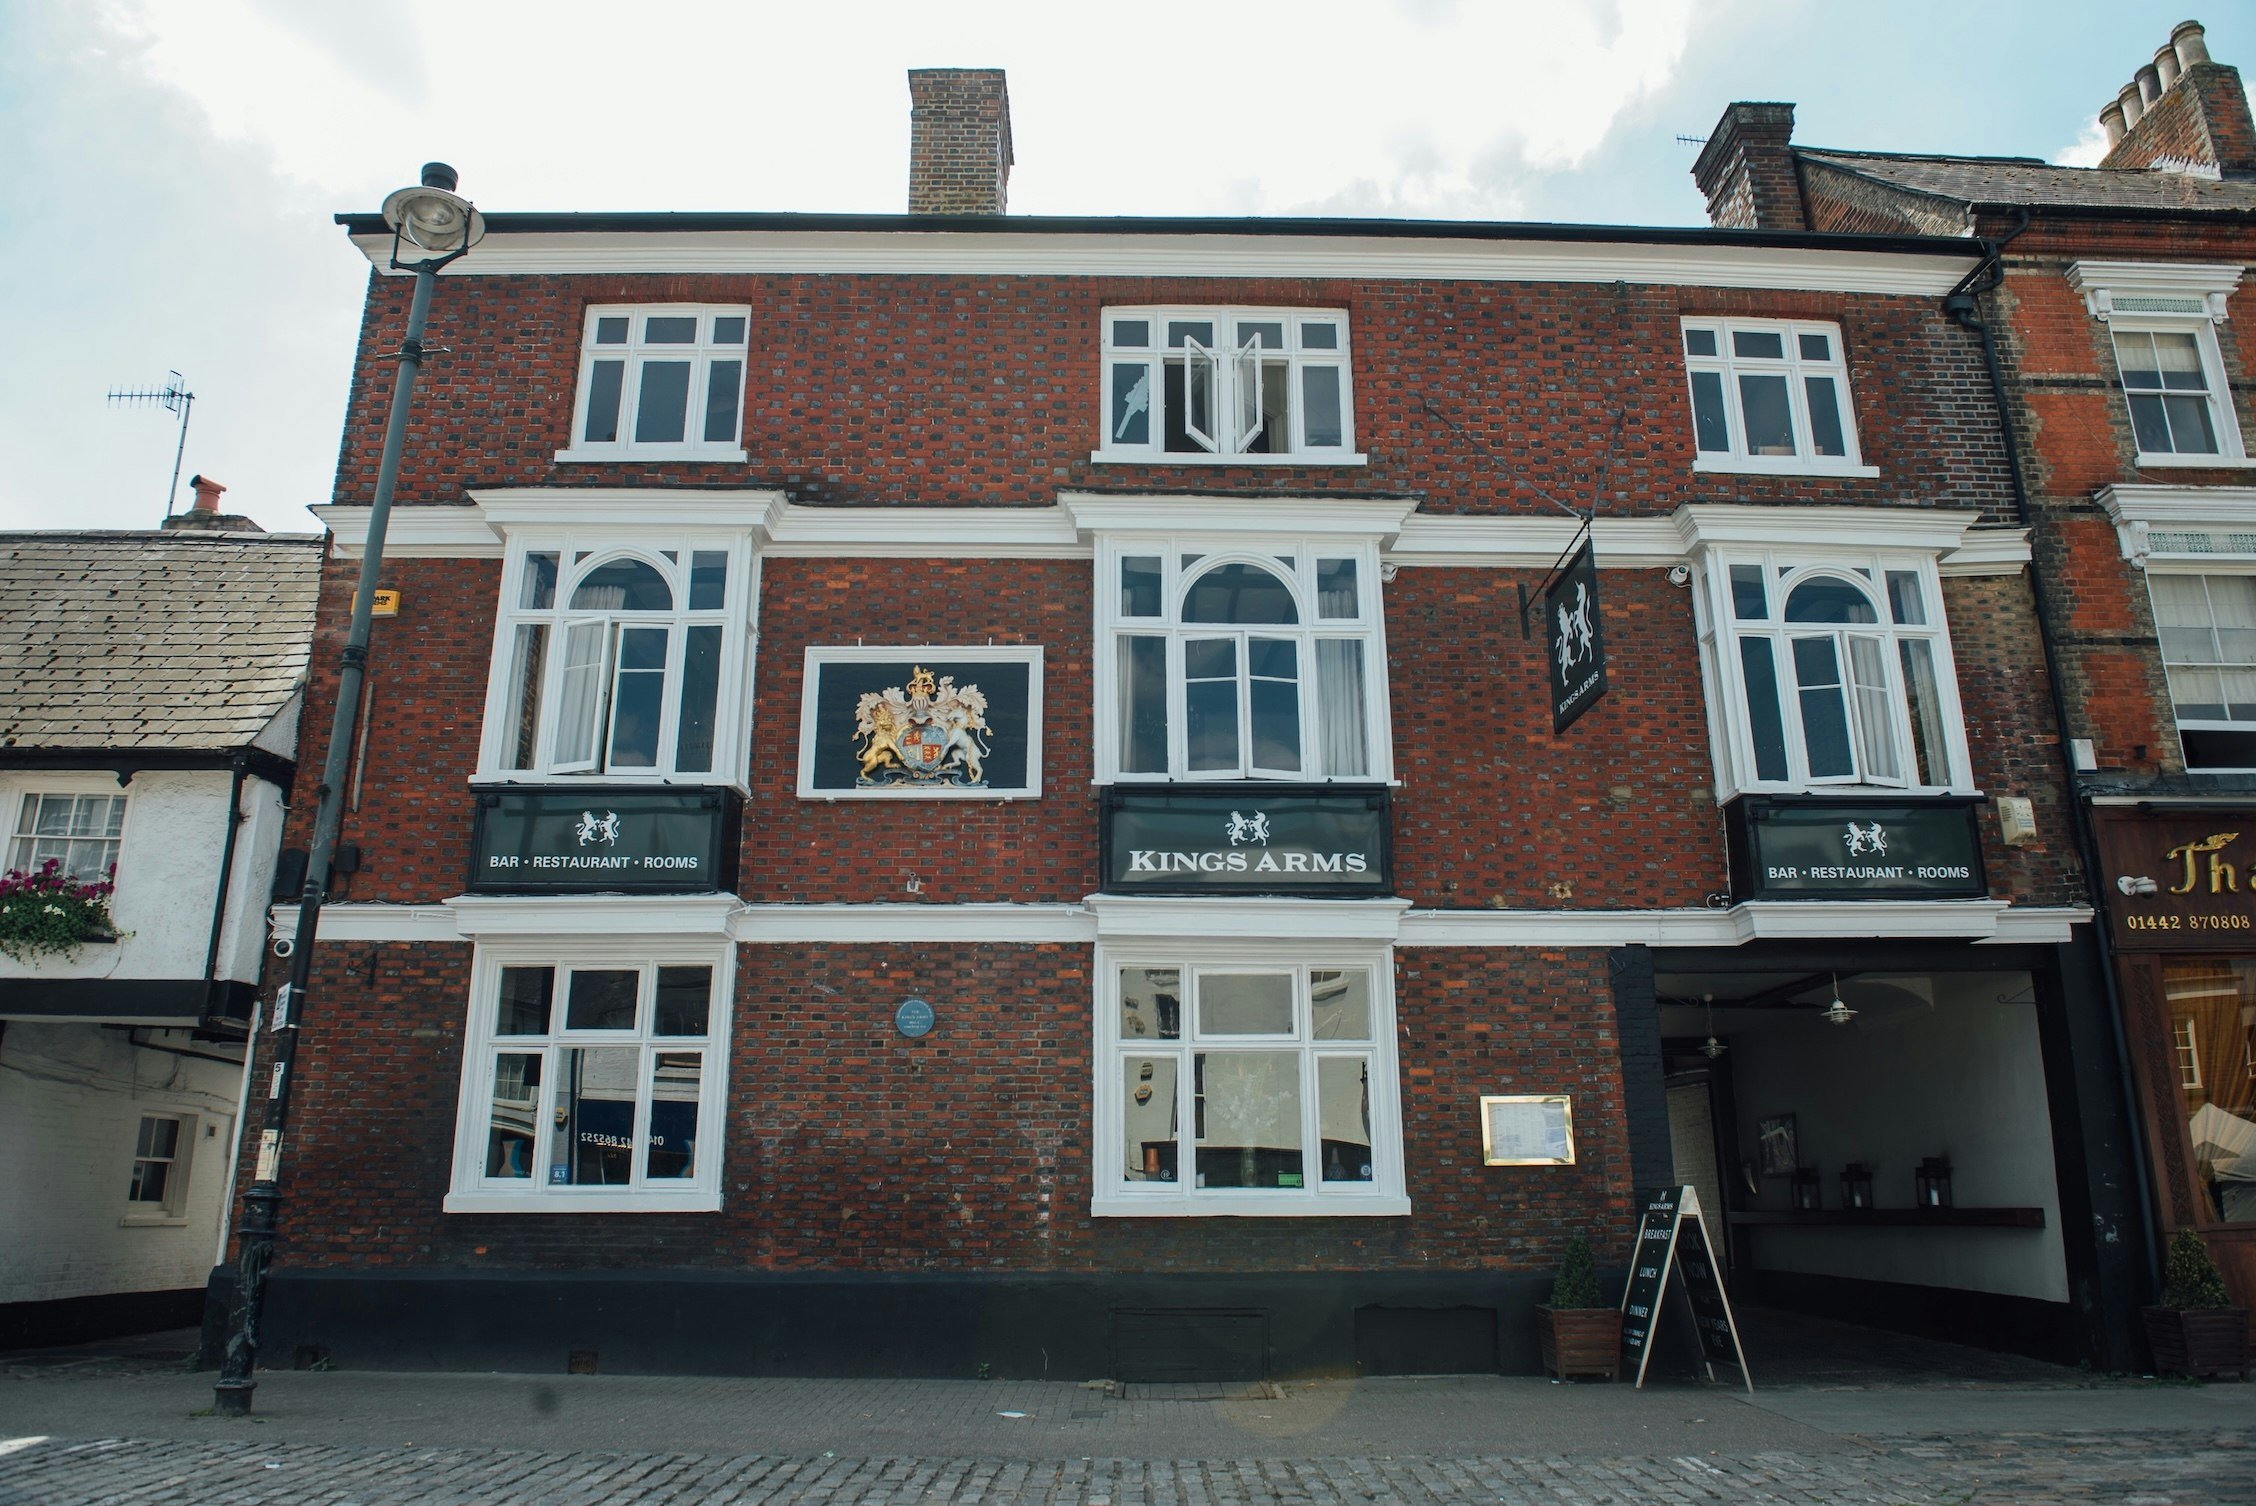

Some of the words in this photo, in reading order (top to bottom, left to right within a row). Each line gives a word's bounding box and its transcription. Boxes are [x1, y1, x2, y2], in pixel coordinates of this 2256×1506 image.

[1558, 688, 1579, 715] KINGS
[1578, 670, 1600, 697] ARMS
[489, 856, 519, 868] BAR
[533, 856, 630, 869] RESTAURANT
[643, 856, 698, 869] ROOMS
[1129, 850, 1248, 872] KINGS
[1254, 851, 1367, 873] ARMS
[2166, 832, 2256, 895] Th
[1768, 867, 1798, 879] BAR
[1811, 866, 1904, 879] RESTAURANT
[1918, 866, 1970, 879] ROOMS
[2127, 915, 2181, 930] 01442
[2189, 915, 2250, 930] 870808
[275, 1063, 282, 1073] 5
[1644, 1229, 1672, 1240] BREAKFAST
[1639, 1267, 1658, 1279] LUNCH
[1629, 1304, 1649, 1319] DINNER
